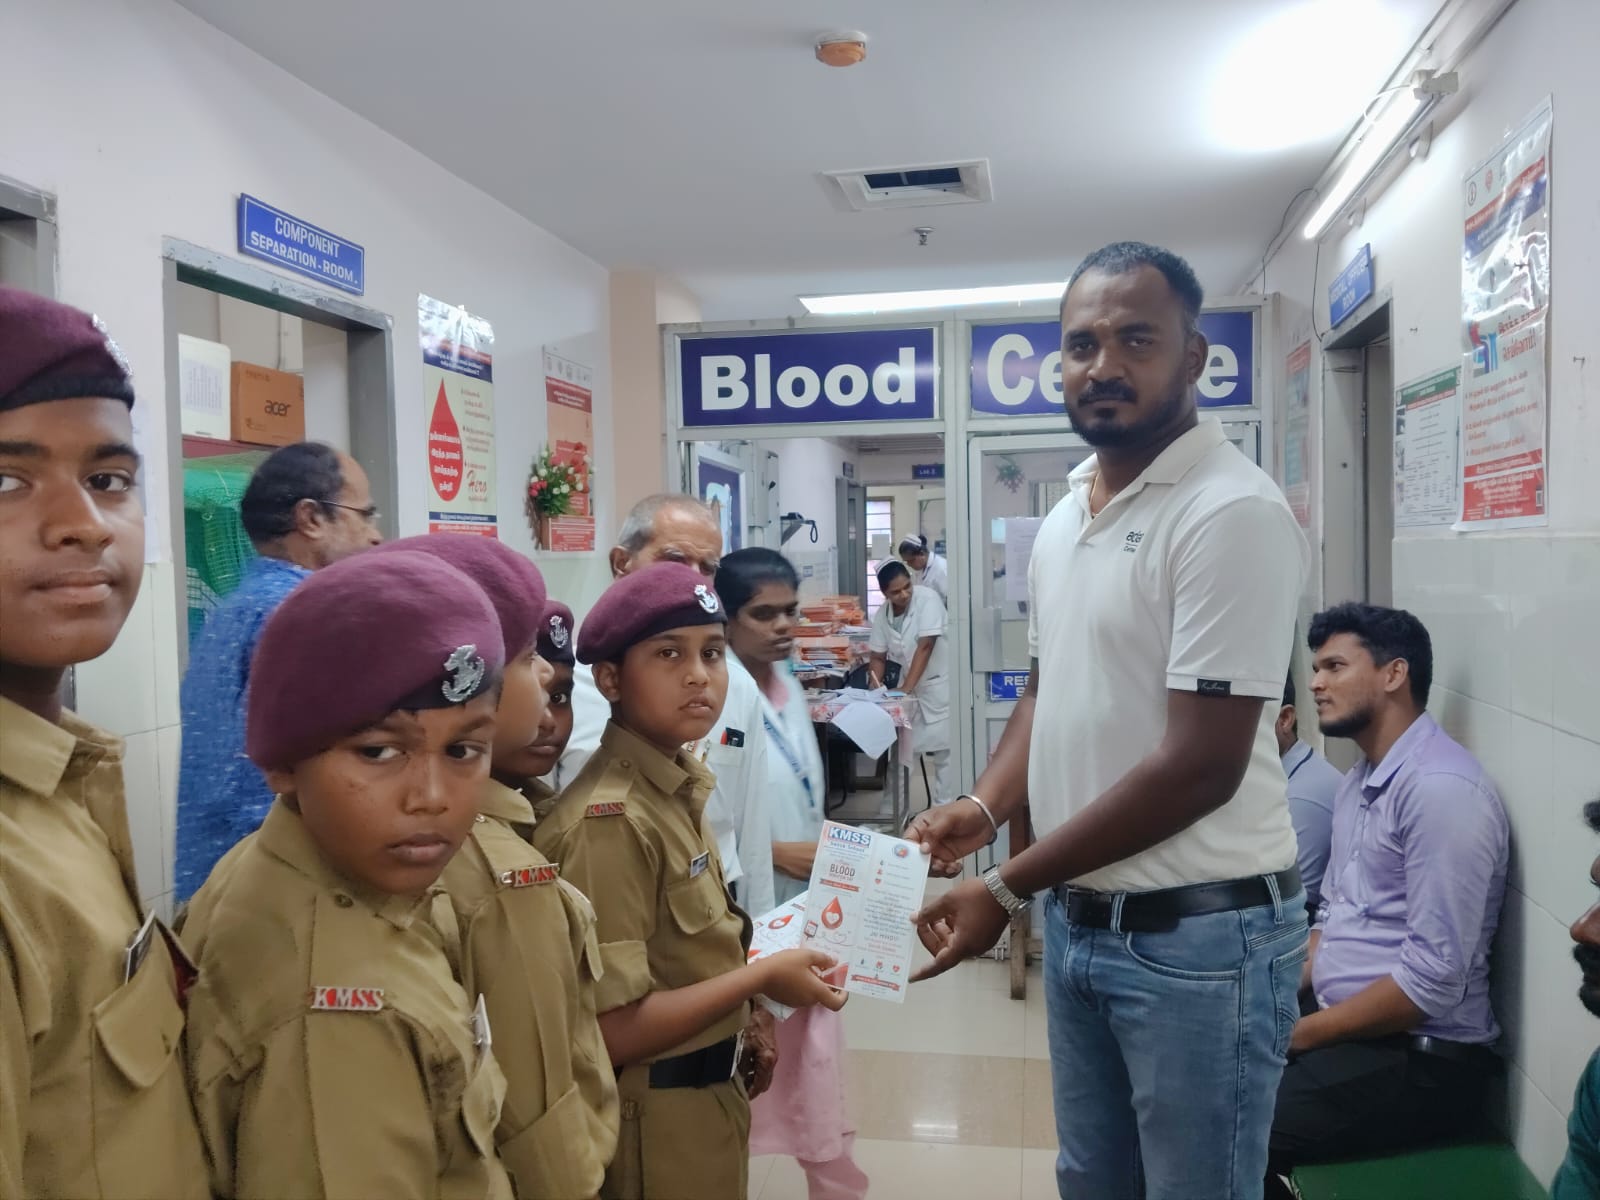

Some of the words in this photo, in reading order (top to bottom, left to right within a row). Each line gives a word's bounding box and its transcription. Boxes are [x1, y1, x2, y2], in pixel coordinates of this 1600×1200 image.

[274, 217, 340, 258] COMPONENT
[701, 346, 916, 411] Blood
[987, 333, 1239, 405] Cee
[264, 399, 291, 417] acer
[587, 802, 625, 817] KMSS
[829, 826, 870, 845] KMSS
[514, 863, 560, 887] KMSS
[830, 863, 856, 877] BLOOD
[311, 985, 384, 1011] KMSS
